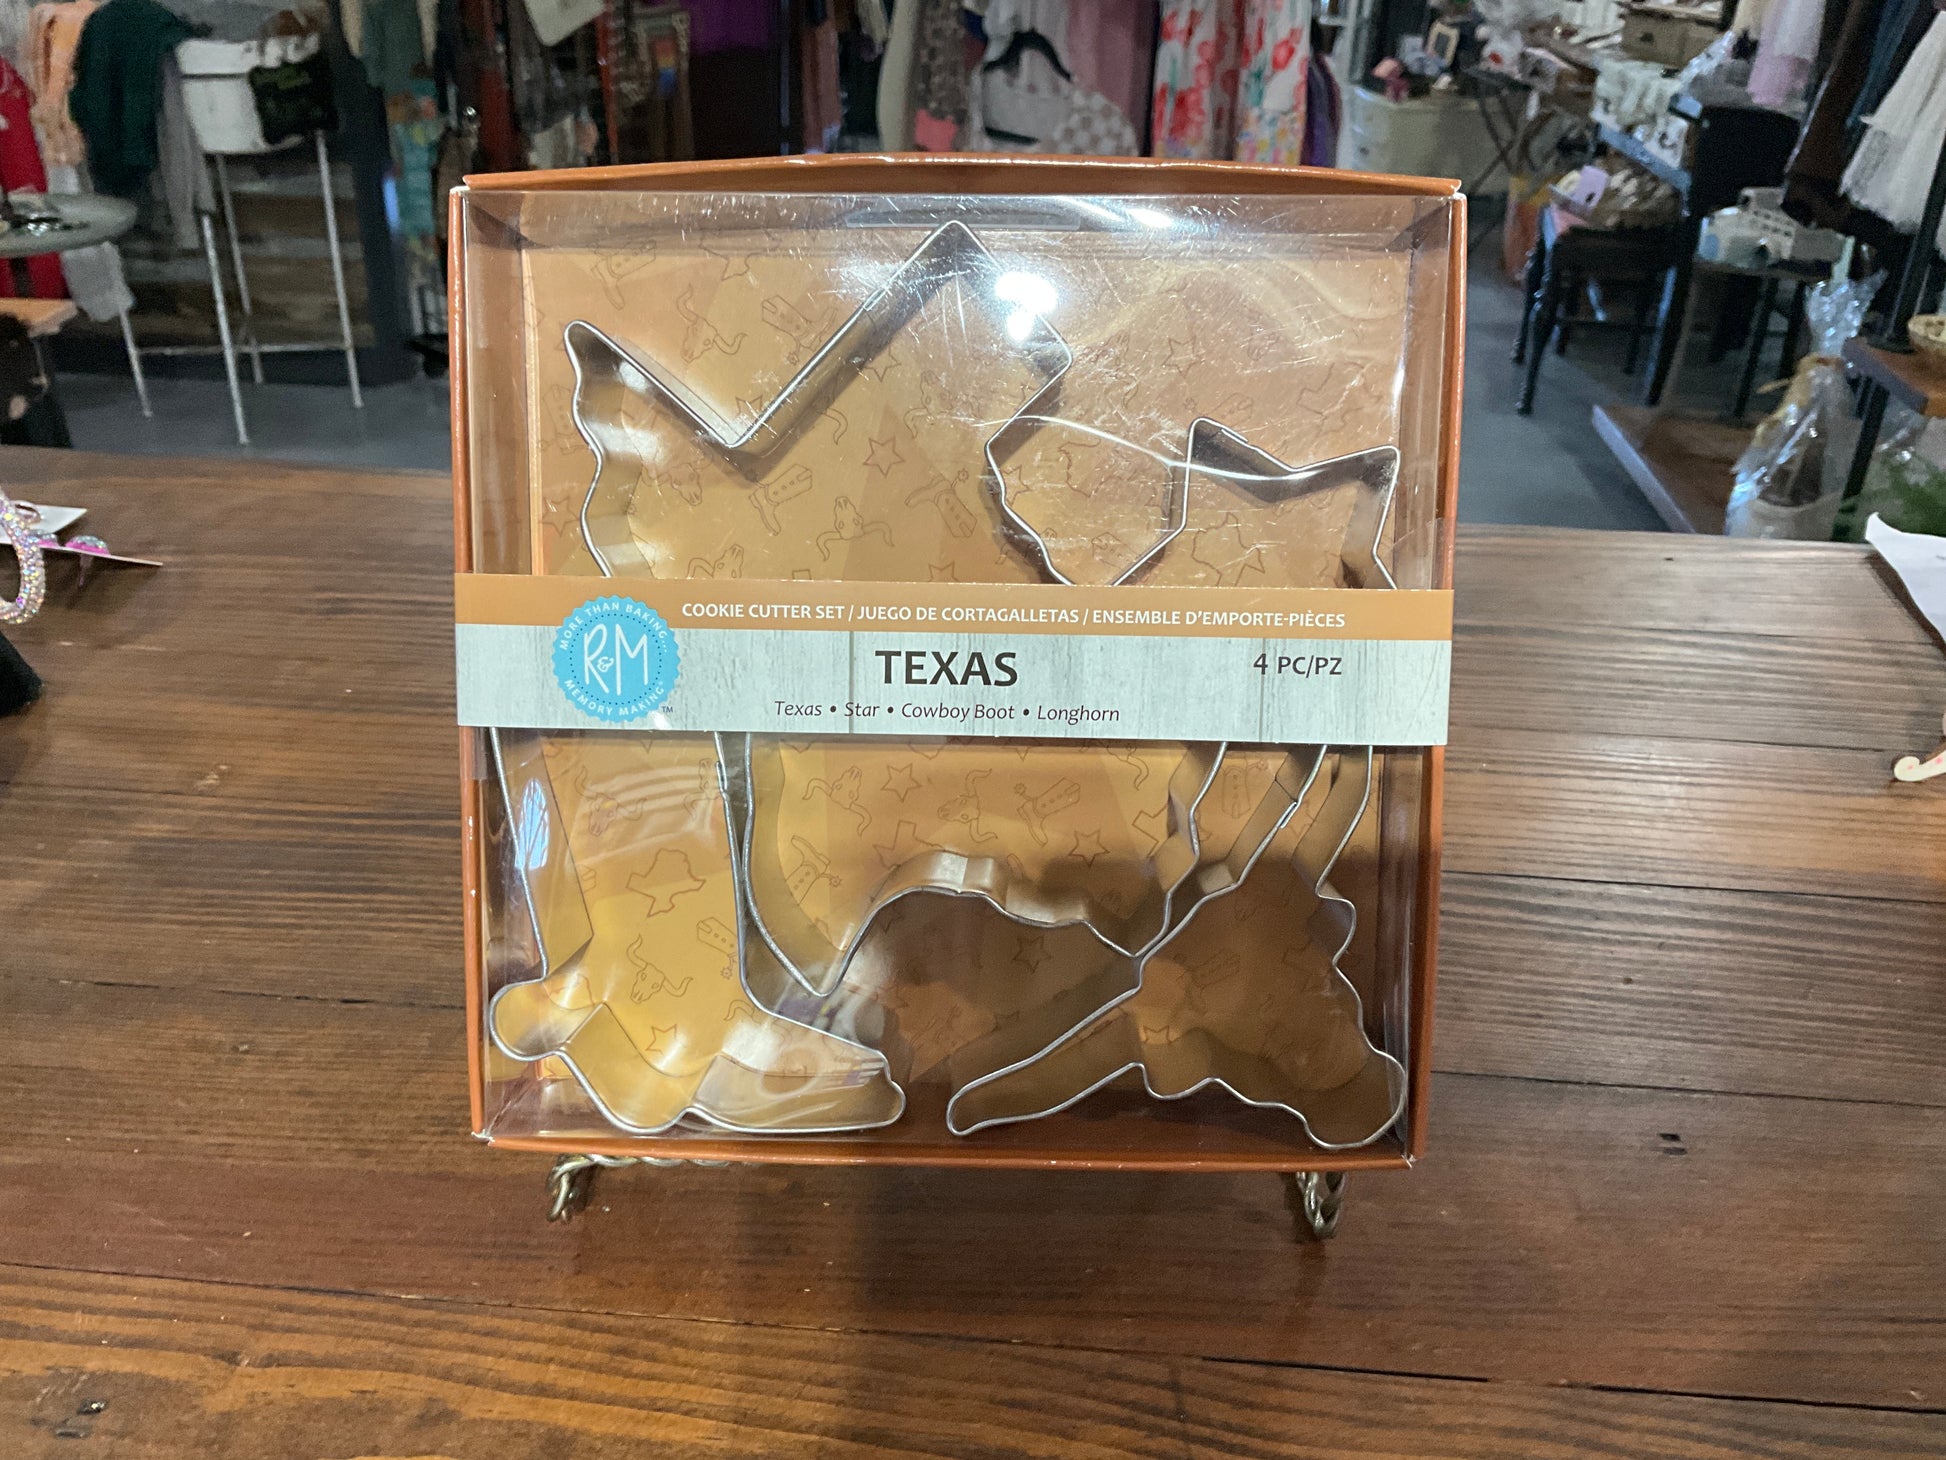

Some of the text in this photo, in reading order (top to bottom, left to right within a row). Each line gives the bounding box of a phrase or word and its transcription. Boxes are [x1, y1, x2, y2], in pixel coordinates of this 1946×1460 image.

[560, 615, 583, 650] MORE
[584, 602, 620, 617] THAN
[682, 603, 744, 619] COOKIE
[749, 604, 811, 619] CUTTER
[815, 604, 844, 620] SET
[857, 606, 911, 621] JUEGO
[917, 607, 936, 621] DE
[942, 607, 1079, 624] CORTAGALLETAS
[1093, 609, 1181, 625] ENSEMBLE
[875, 650, 1018, 687] TEXAS
[1253, 653, 1343, 678] 4 PC/PZ
[564, 679, 613, 716] MEMORY
[774, 700, 1119, 724] Texas Star Cowboy Boot Longhorn
